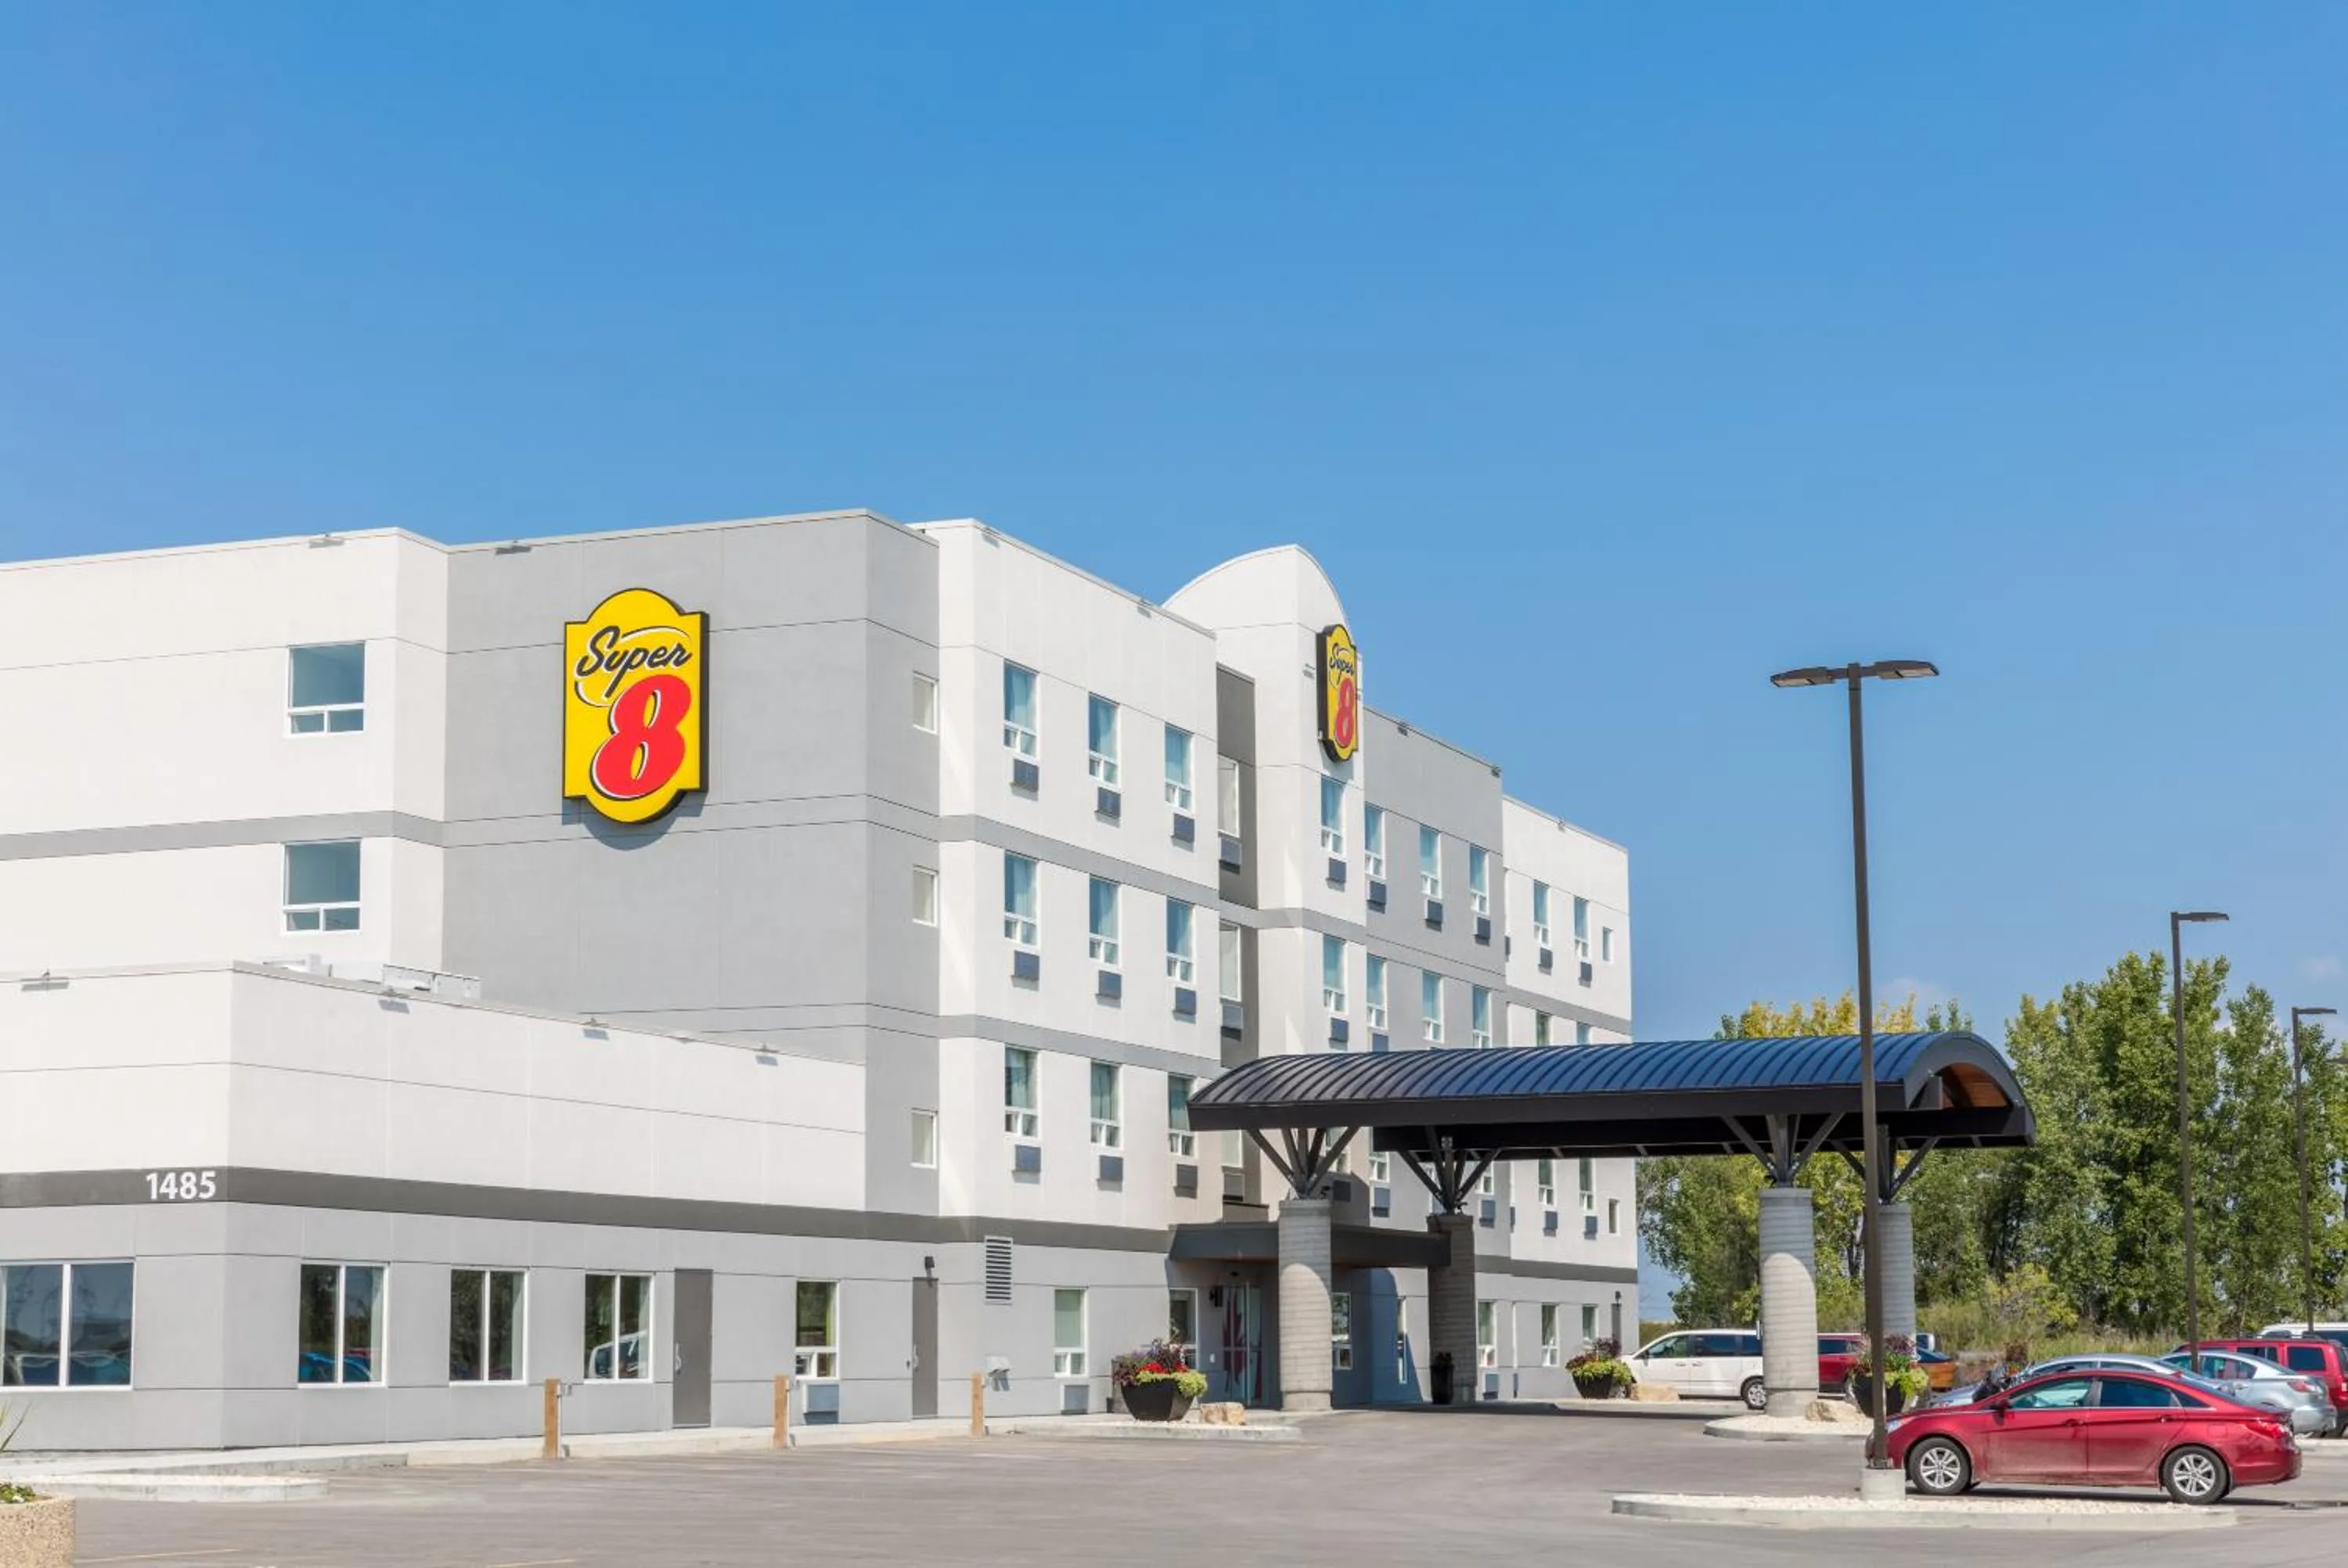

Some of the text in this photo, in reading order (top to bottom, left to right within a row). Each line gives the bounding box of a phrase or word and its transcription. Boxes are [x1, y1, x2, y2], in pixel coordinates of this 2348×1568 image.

[575, 625, 692, 699] Super
[1330, 642, 1354, 685] Super
[589, 674, 691, 801] 8
[1334, 678, 1354, 748] 8
[146, 1171, 216, 1199] 1485
